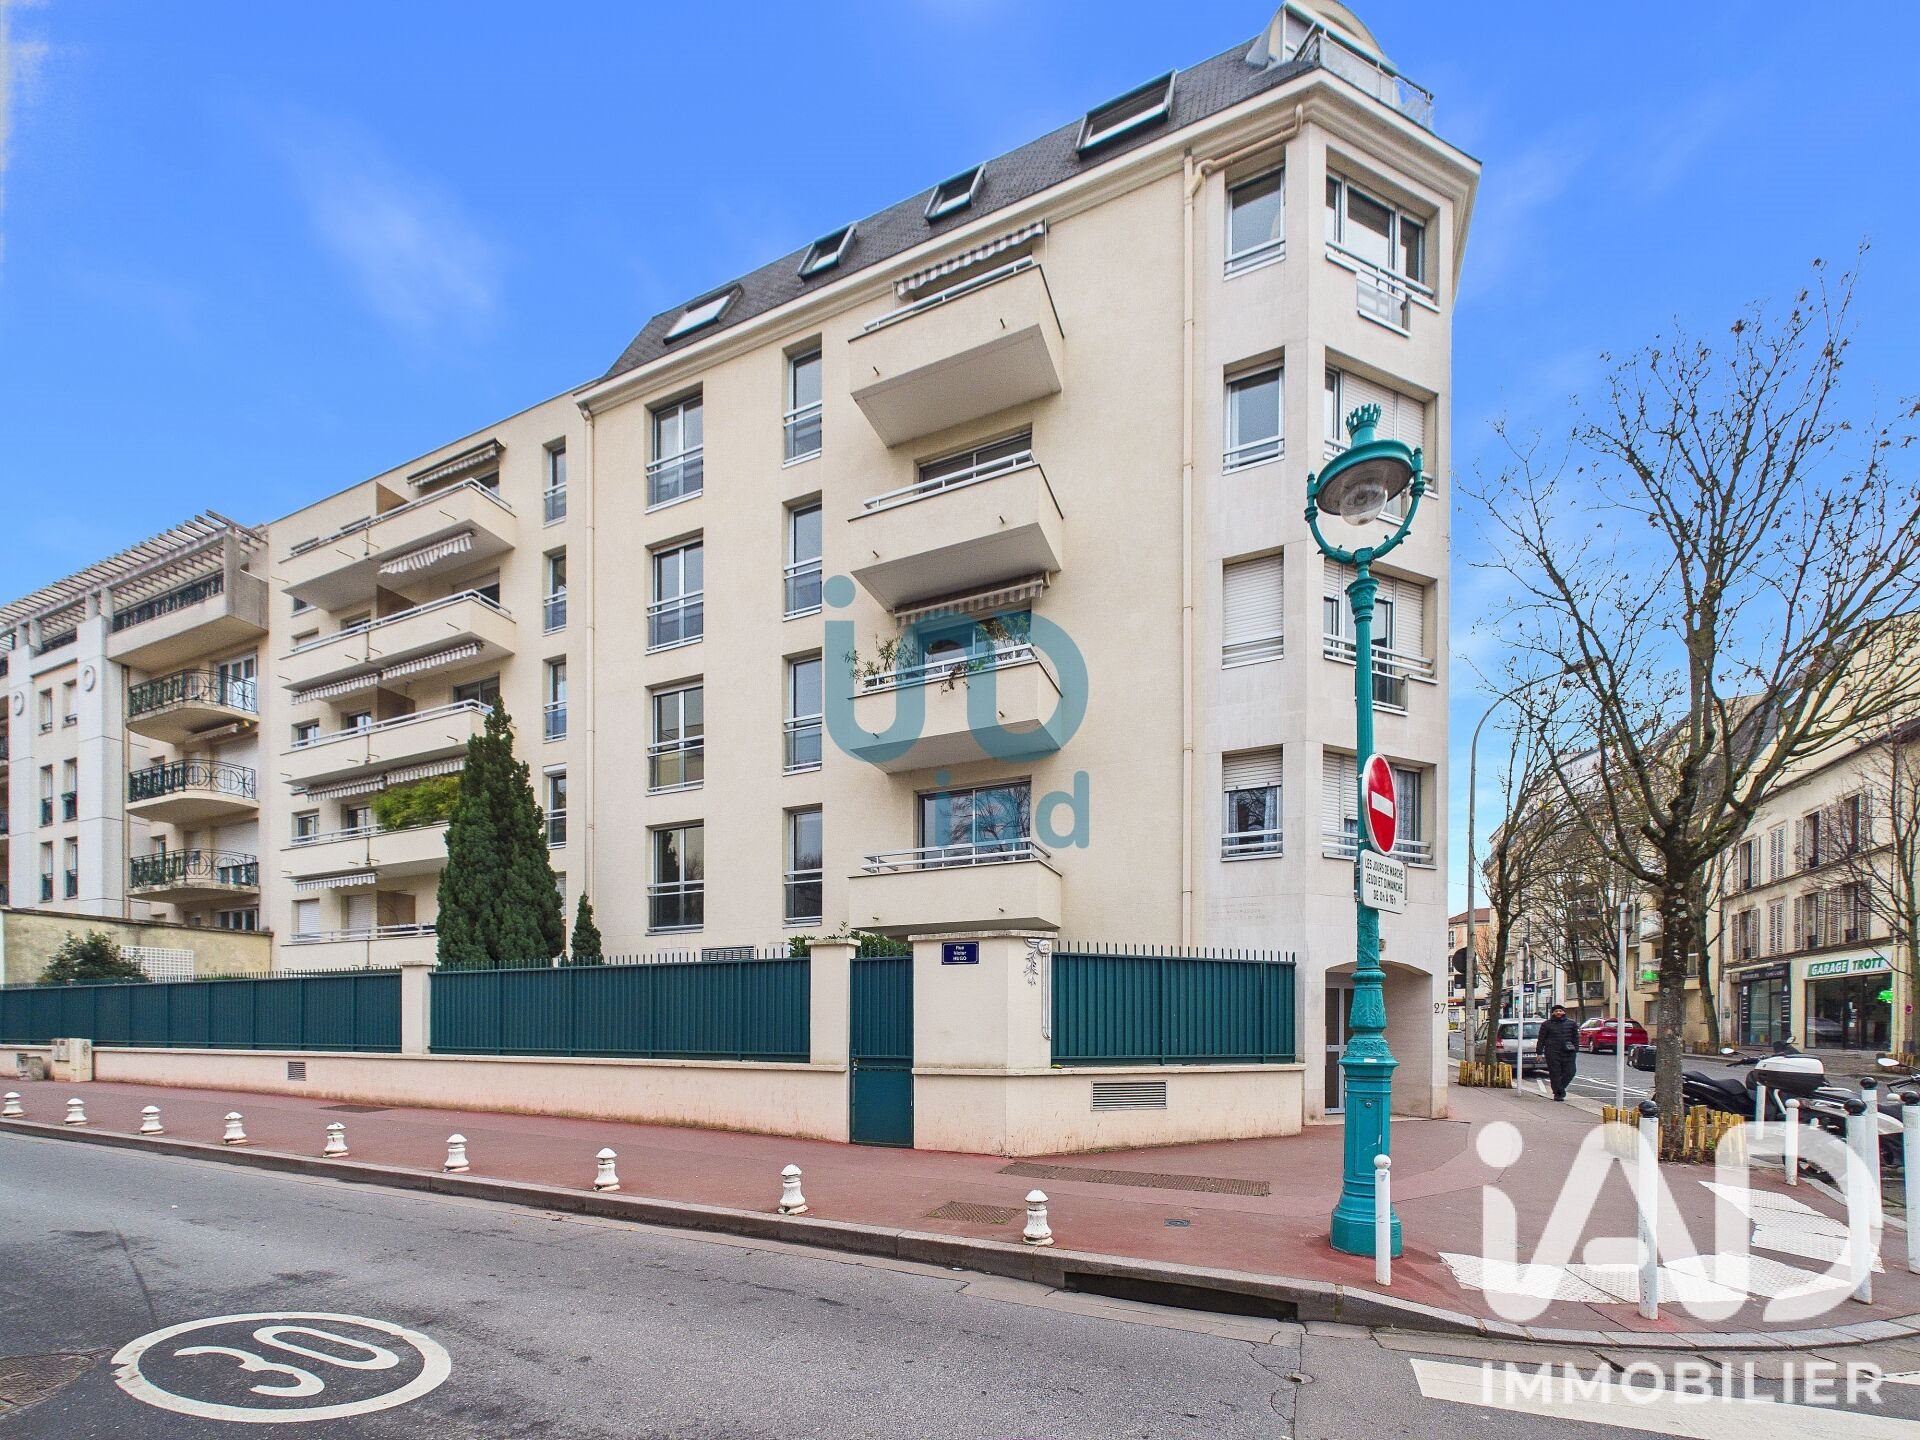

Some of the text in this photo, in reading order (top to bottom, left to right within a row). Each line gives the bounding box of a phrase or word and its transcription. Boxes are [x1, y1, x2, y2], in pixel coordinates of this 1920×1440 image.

[1384, 878, 1403, 894] DIMANCHE
[1811, 960, 1847, 976] GARAGE
[1433, 1002, 1447, 1014] 27
[173, 1325, 400, 1397] 30
